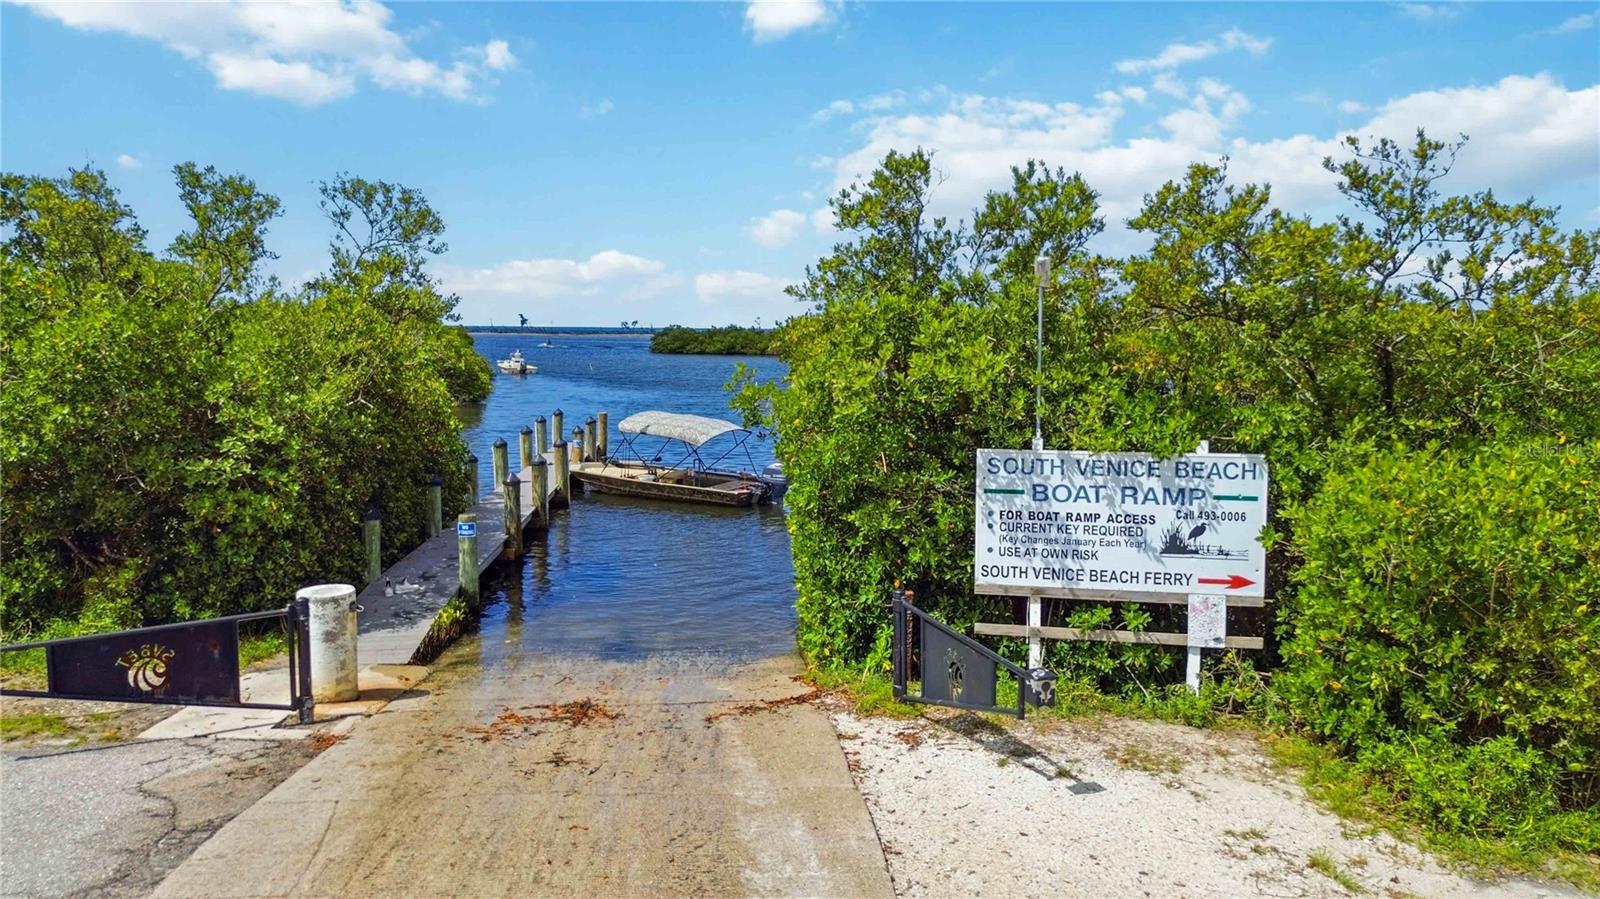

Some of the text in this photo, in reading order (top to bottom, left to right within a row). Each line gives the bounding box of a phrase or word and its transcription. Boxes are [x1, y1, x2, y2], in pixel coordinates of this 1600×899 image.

[987, 457, 1257, 480] SOUTH VENICE BEACH
[1031, 483, 1206, 506] BOAT RAMP
[999, 510, 1156, 525] FOR BOAT RAMP ACCESS
[1175, 510, 1247, 522] Call 493-0006
[999, 521, 1144, 537] CURRENT KEY REQUIRED
[998, 534, 1147, 550] (Key Changes January Each Year)
[998, 546, 1099, 561] USE AT OWN RISK
[980, 564, 1193, 587] SOUTH VENICE BEACH FERRY
